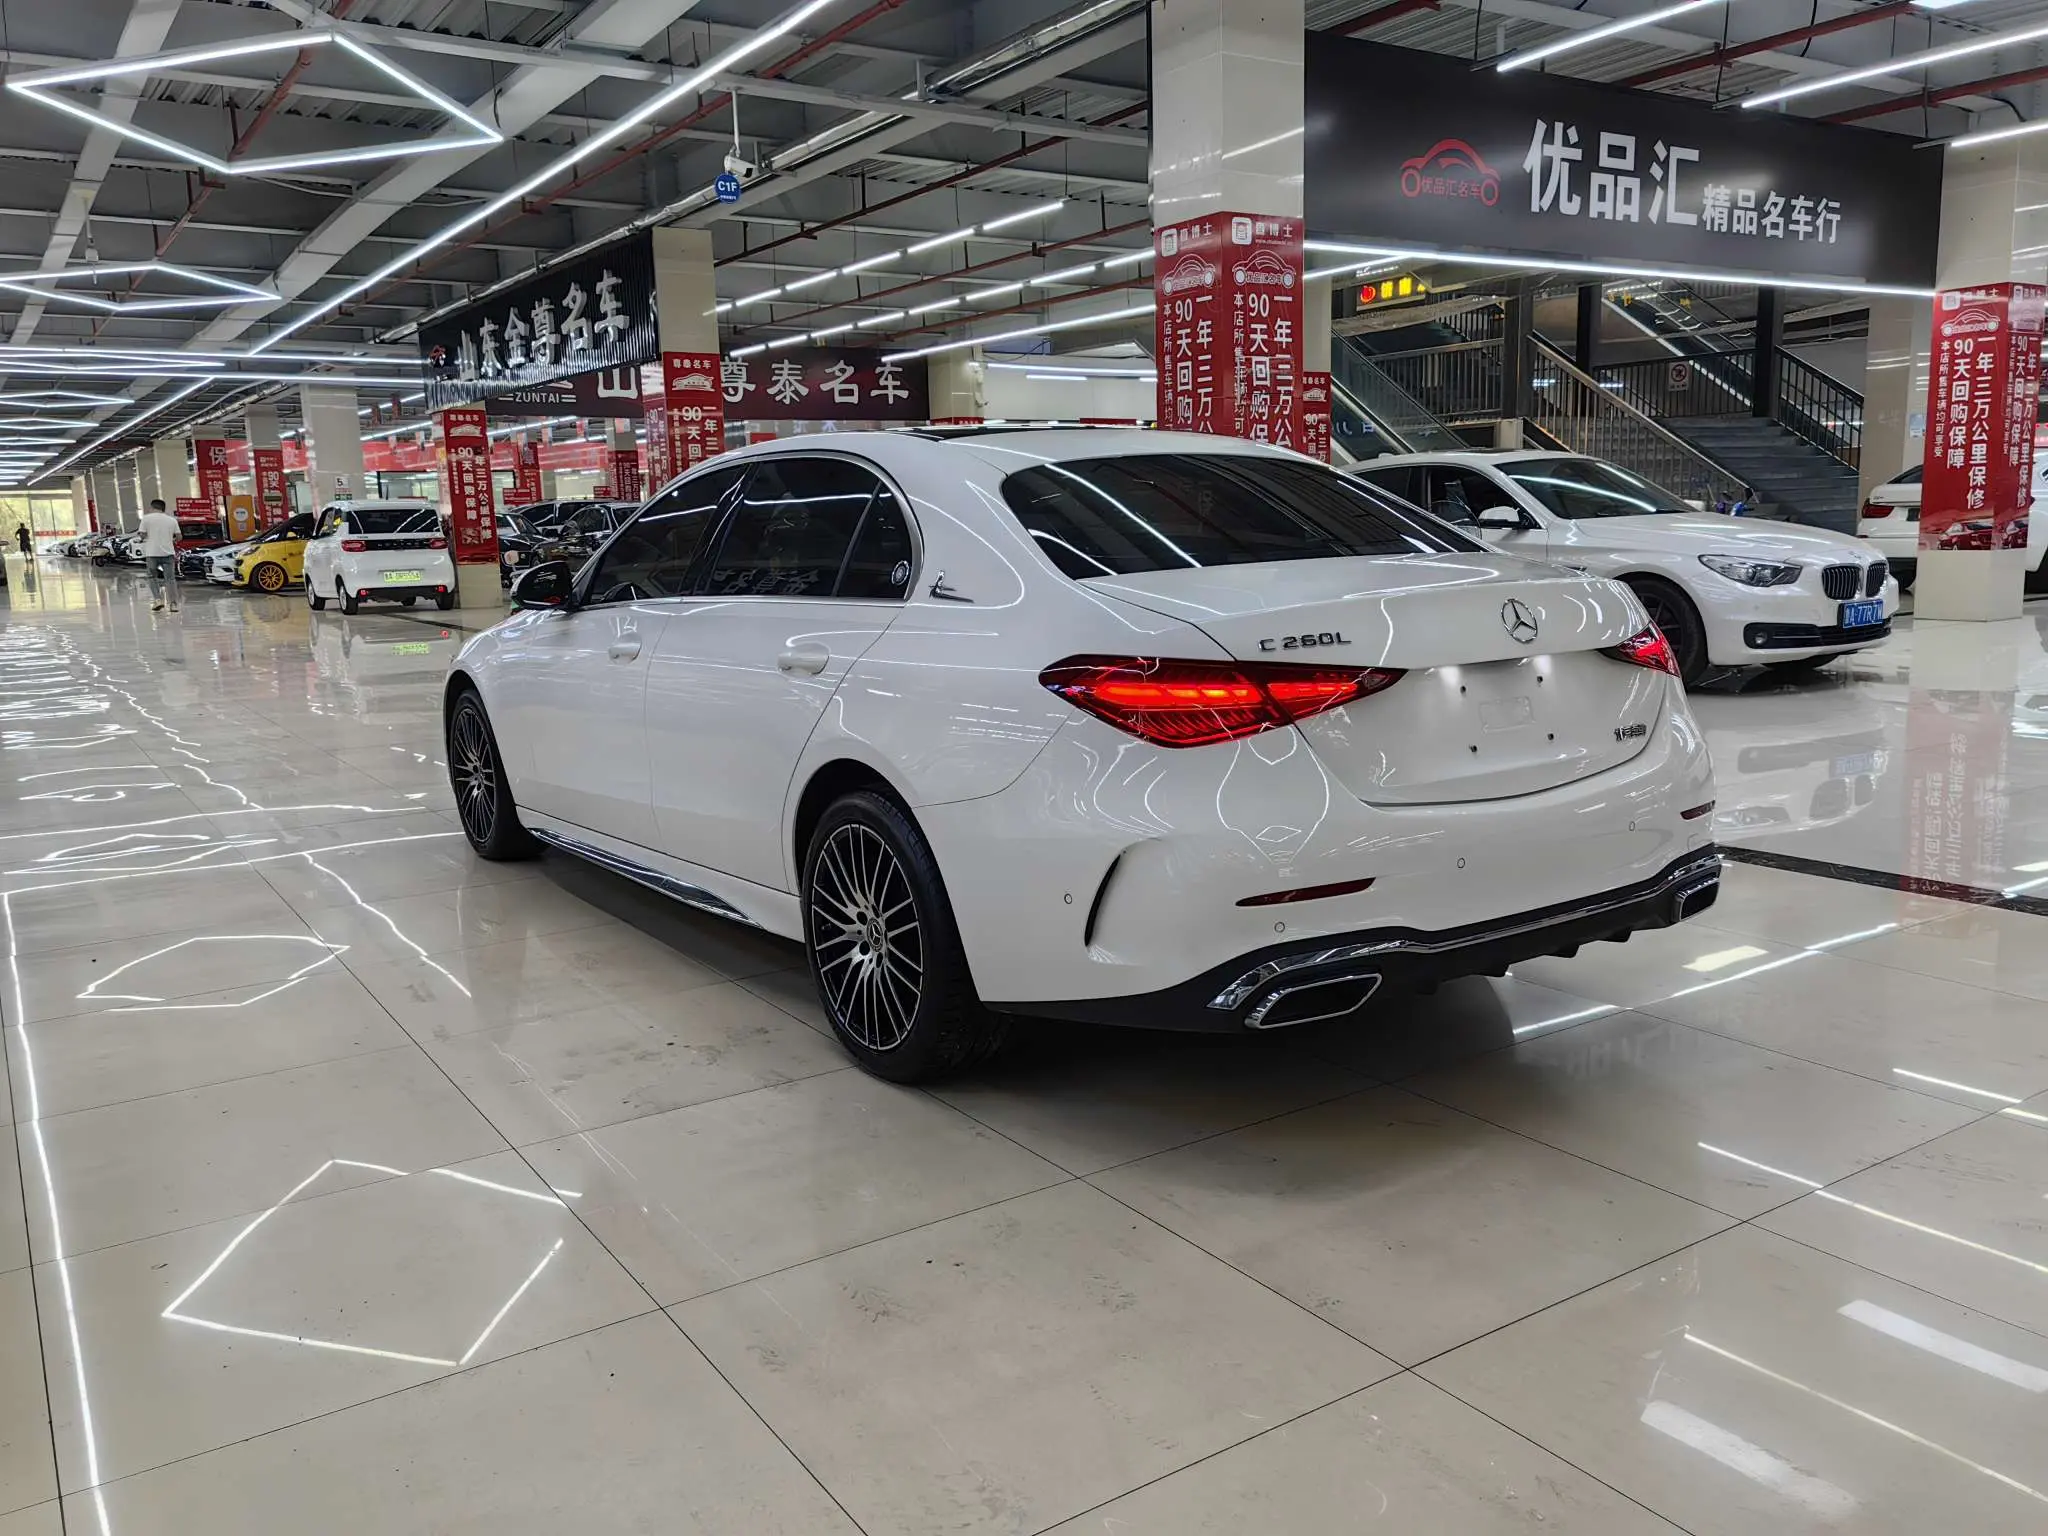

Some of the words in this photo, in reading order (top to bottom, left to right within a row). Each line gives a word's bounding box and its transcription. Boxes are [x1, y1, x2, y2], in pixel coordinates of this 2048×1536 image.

[718, 181, 737, 192] C1F
[1420, 175, 1482, 199] 优品汇名车
[1522, 118, 1699, 225] 优品汇
[1701, 183, 1839, 244] 精品名车行
[514, 392, 559, 403] ZUNTAI
[1163, 302, 1174, 427] 本店所售车辆均
[1175, 298, 1193, 431] 90天回购
[1233, 292, 1247, 438] 本店所售车辆均可
[1947, 339, 1973, 468] 90天回购保障
[1966, 336, 1996, 509] 一年三万公里保修
[1258, 638, 1277, 651] C
[1281, 631, 1352, 650] 260L
